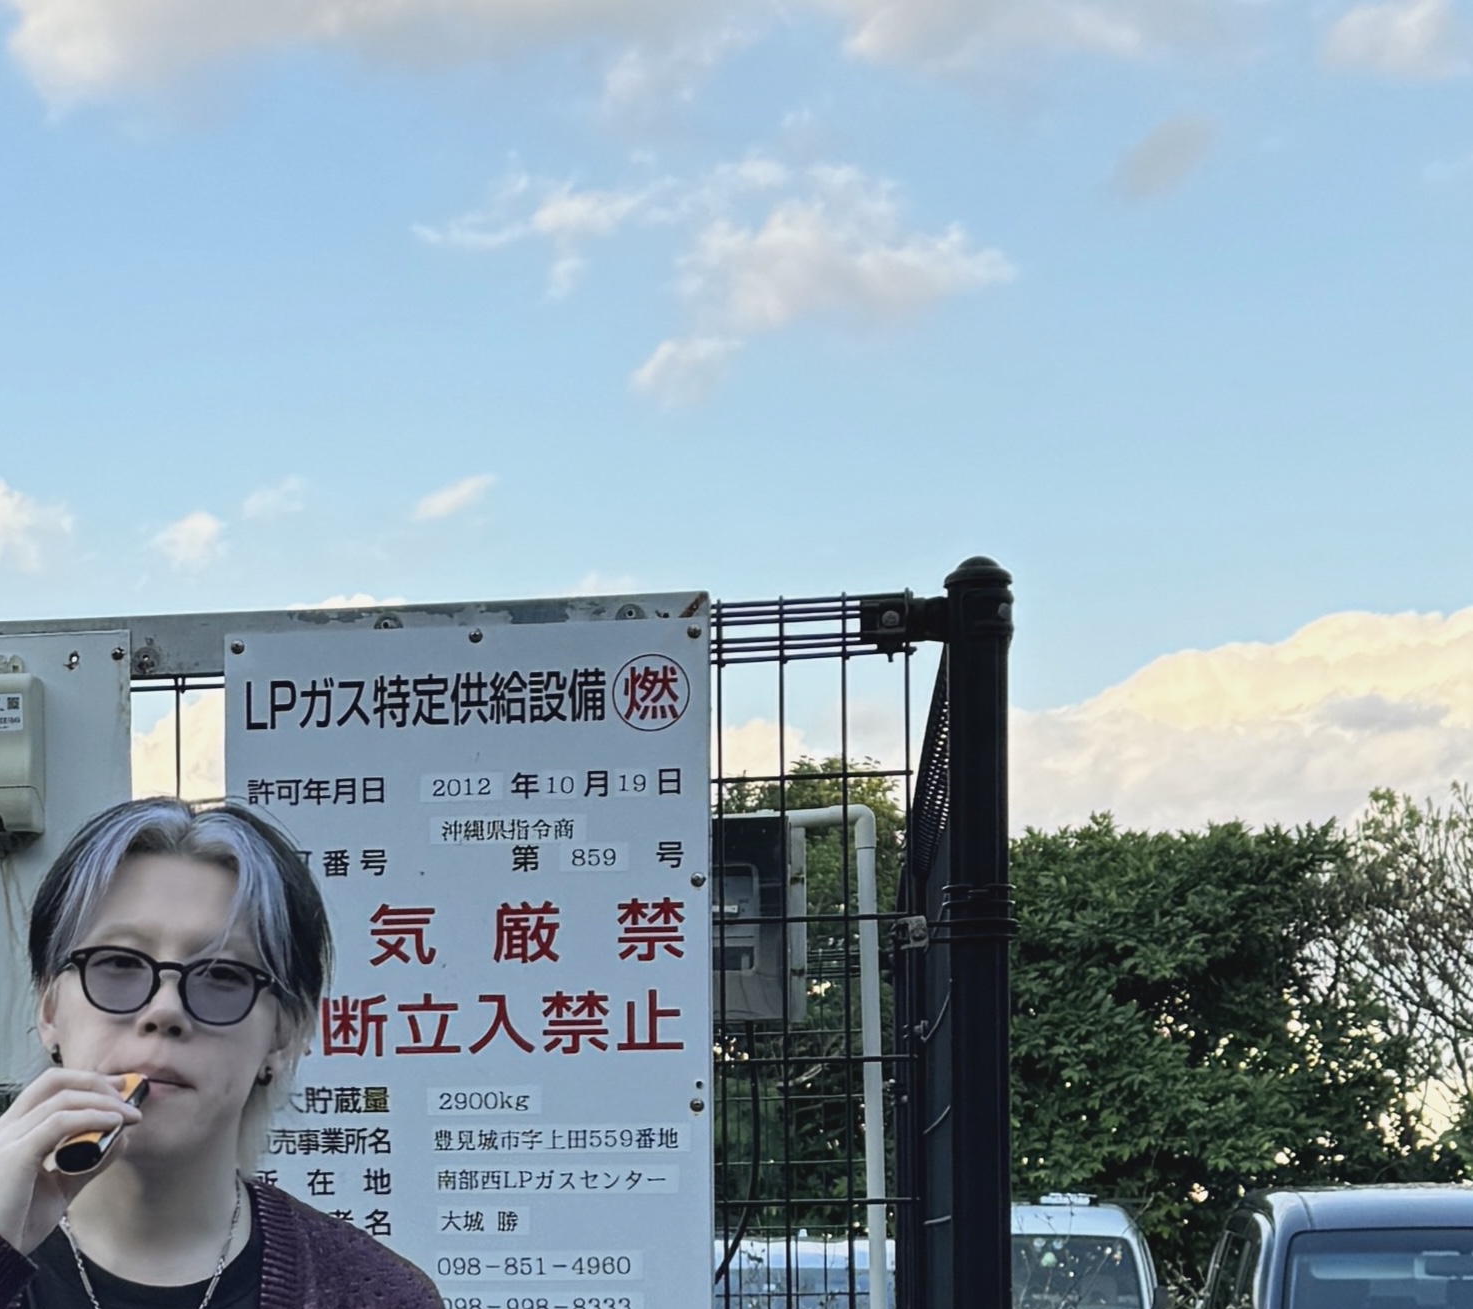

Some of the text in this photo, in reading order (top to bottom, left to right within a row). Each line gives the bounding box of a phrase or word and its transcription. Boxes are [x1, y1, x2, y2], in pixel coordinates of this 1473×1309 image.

[245, 661, 683, 730] LPガス特定供給設備 燃
[247, 777, 385, 806] 許可年月日
[438, 1091, 530, 1112] 2900kg
[267, 1127, 391, 1155] 売事業所名
[433, 1127, 679, 1151] 豊見城市字上田559番地
[437, 1169, 667, 1191] 南部西LPガスセンター
